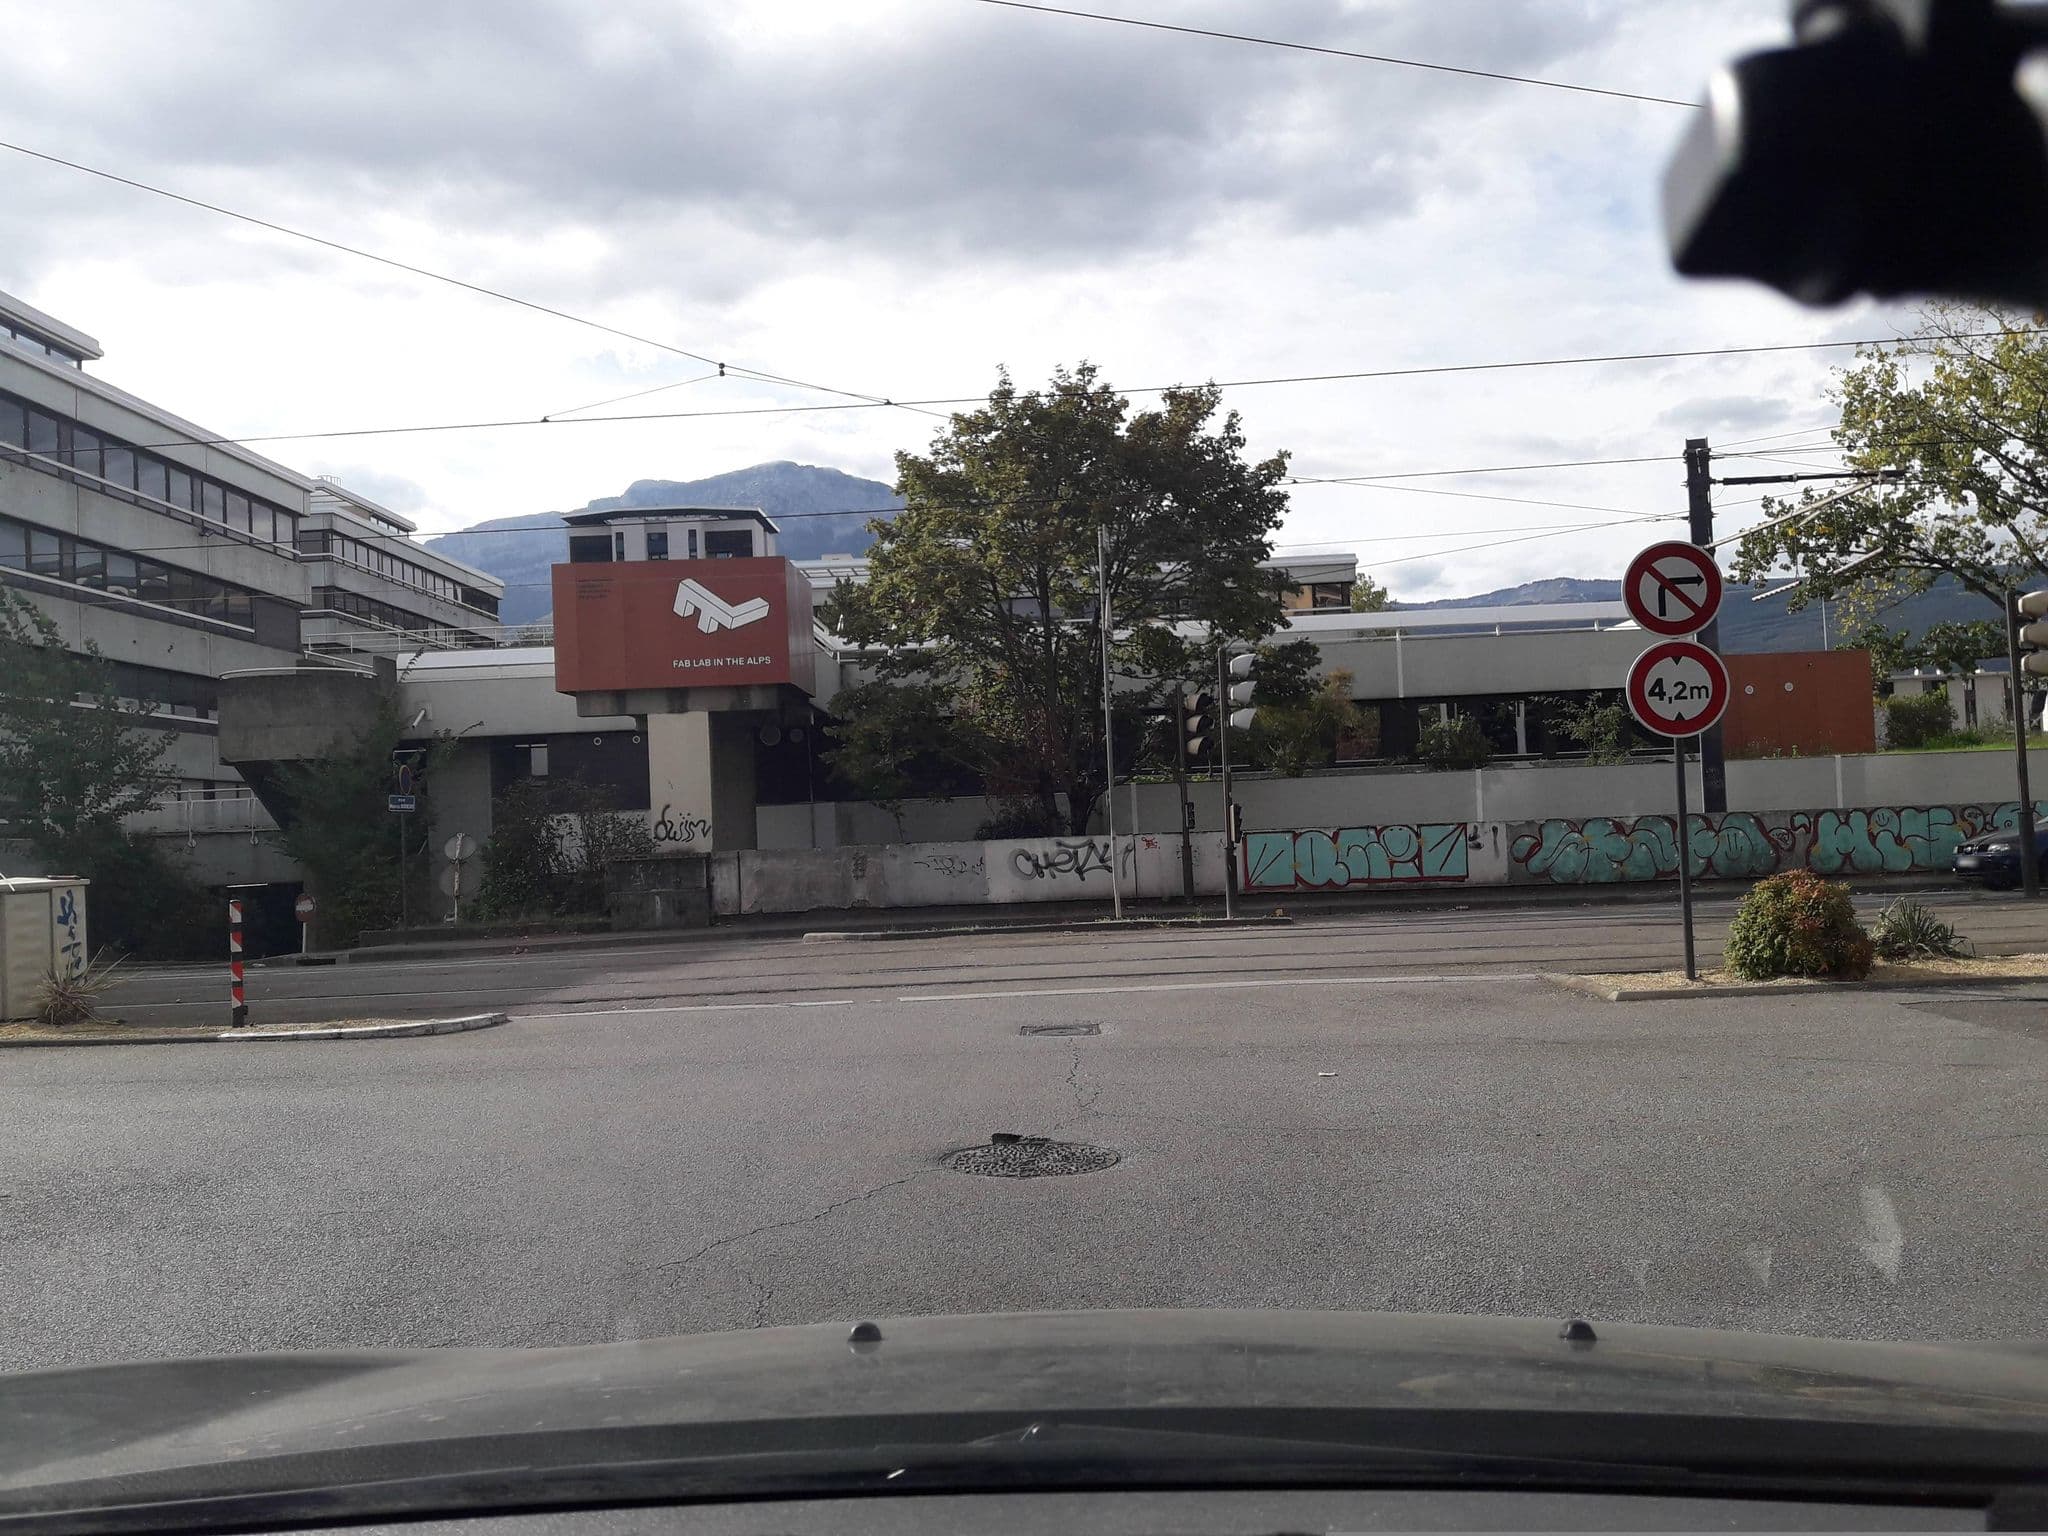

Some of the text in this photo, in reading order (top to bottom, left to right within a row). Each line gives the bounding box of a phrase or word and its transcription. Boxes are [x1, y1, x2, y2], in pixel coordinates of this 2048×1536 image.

[673, 656, 771, 669] FAB LAB IN THE ALPS
[1648, 677, 1710, 704] 4,2m
